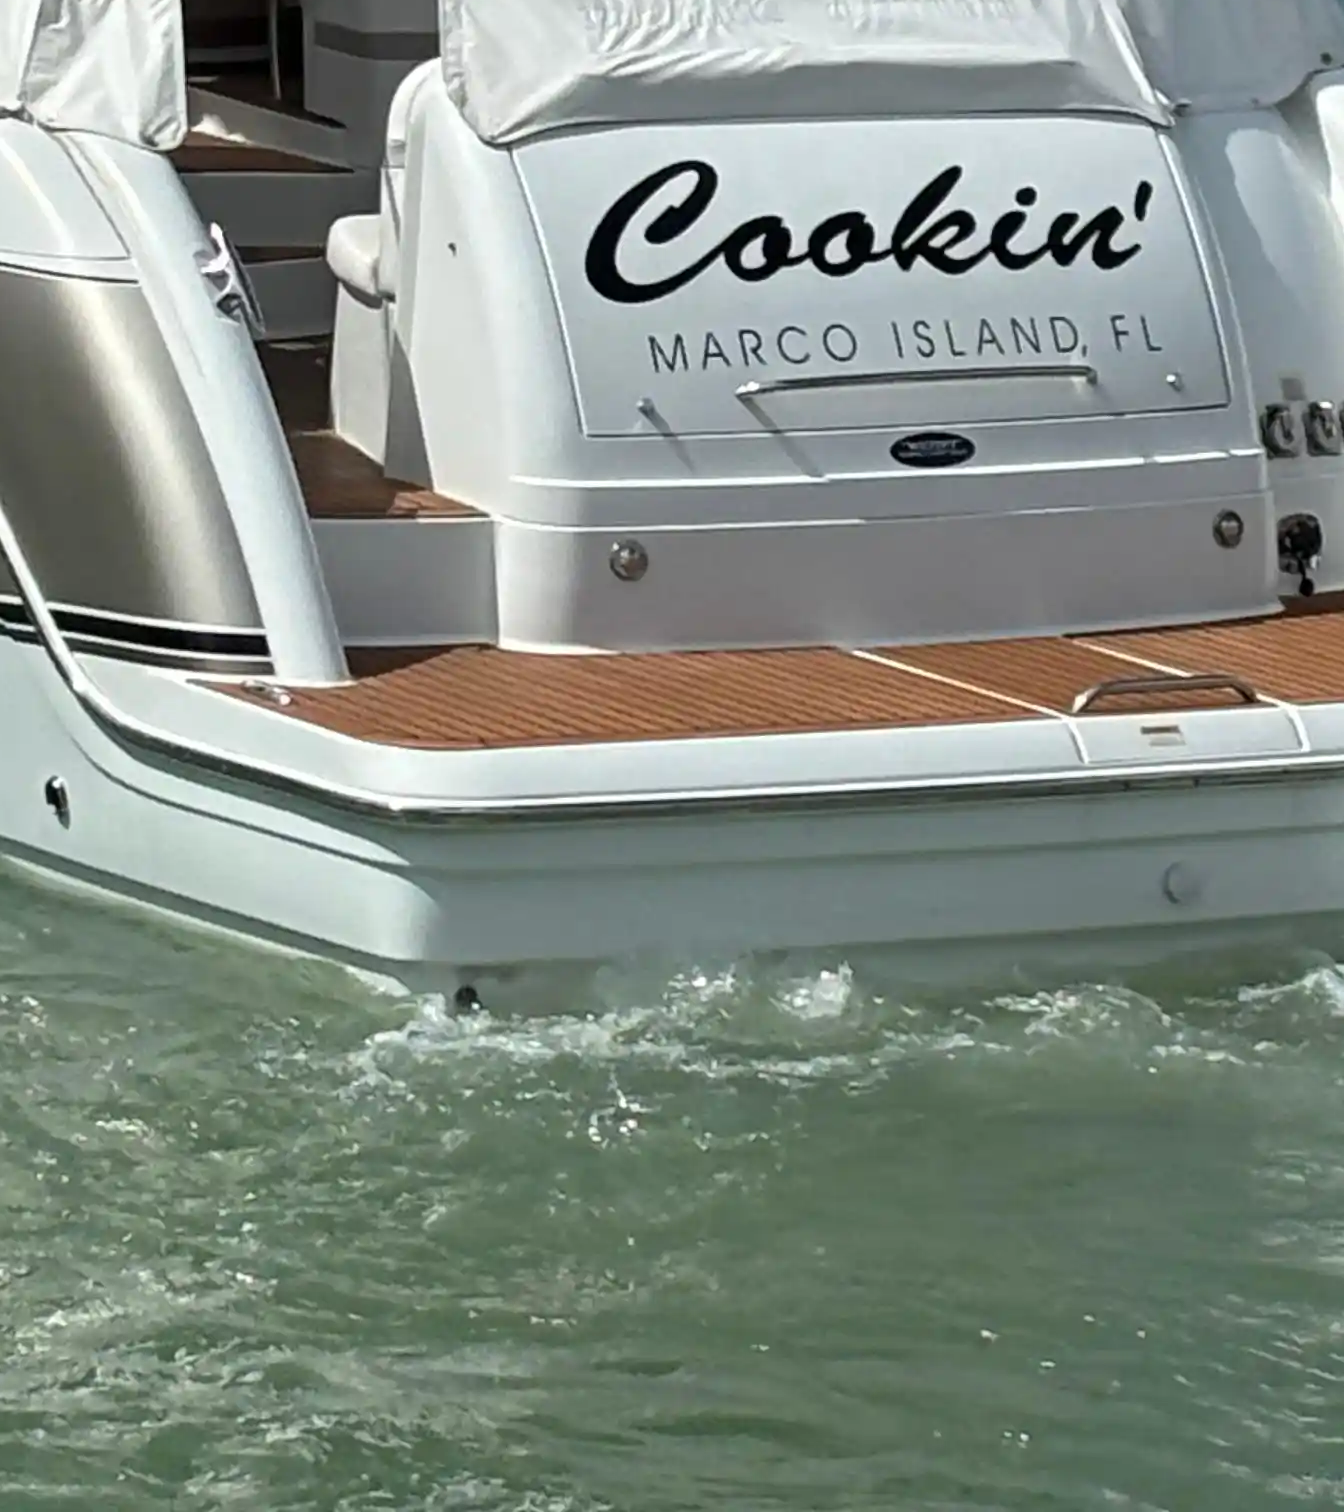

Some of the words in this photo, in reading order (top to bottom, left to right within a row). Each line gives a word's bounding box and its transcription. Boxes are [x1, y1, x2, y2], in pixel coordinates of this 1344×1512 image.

[584, 159, 1154, 305] Cookin'
[647, 323, 858, 374] MARCO
[890, 315, 1090, 360] ISLAND,
[1109, 313, 1165, 359] FL
